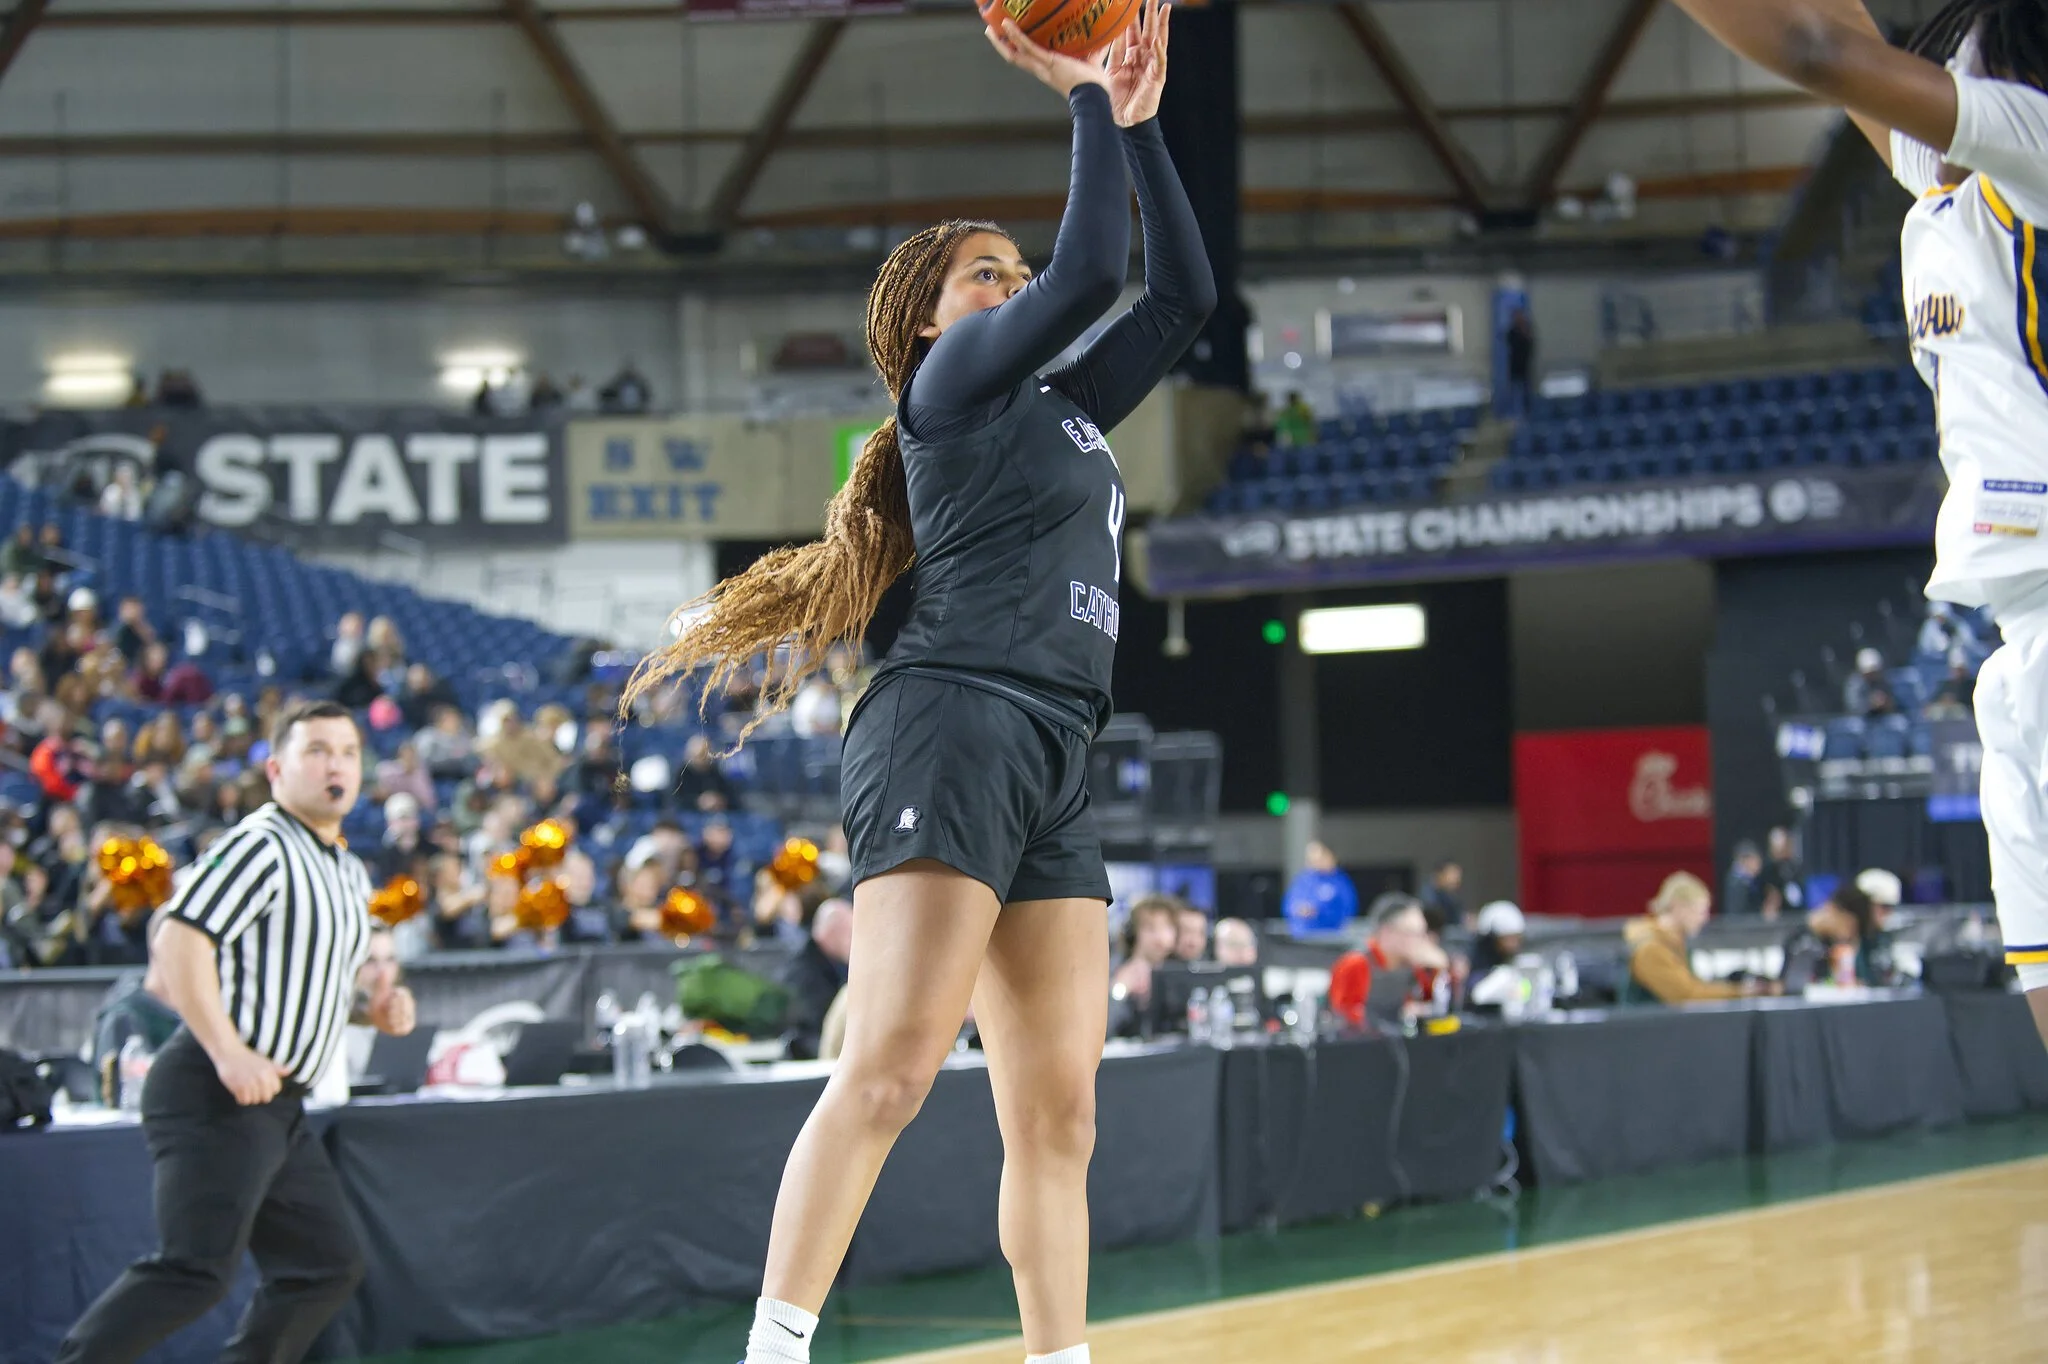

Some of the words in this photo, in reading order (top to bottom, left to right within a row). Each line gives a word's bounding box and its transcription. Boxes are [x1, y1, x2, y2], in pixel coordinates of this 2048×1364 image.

[195, 434, 549, 526] STATE
[587, 482, 726, 522] EXIT
[1284, 511, 1406, 560] STATE
[1408, 483, 1764, 550] CHAMPIONSHIPS
